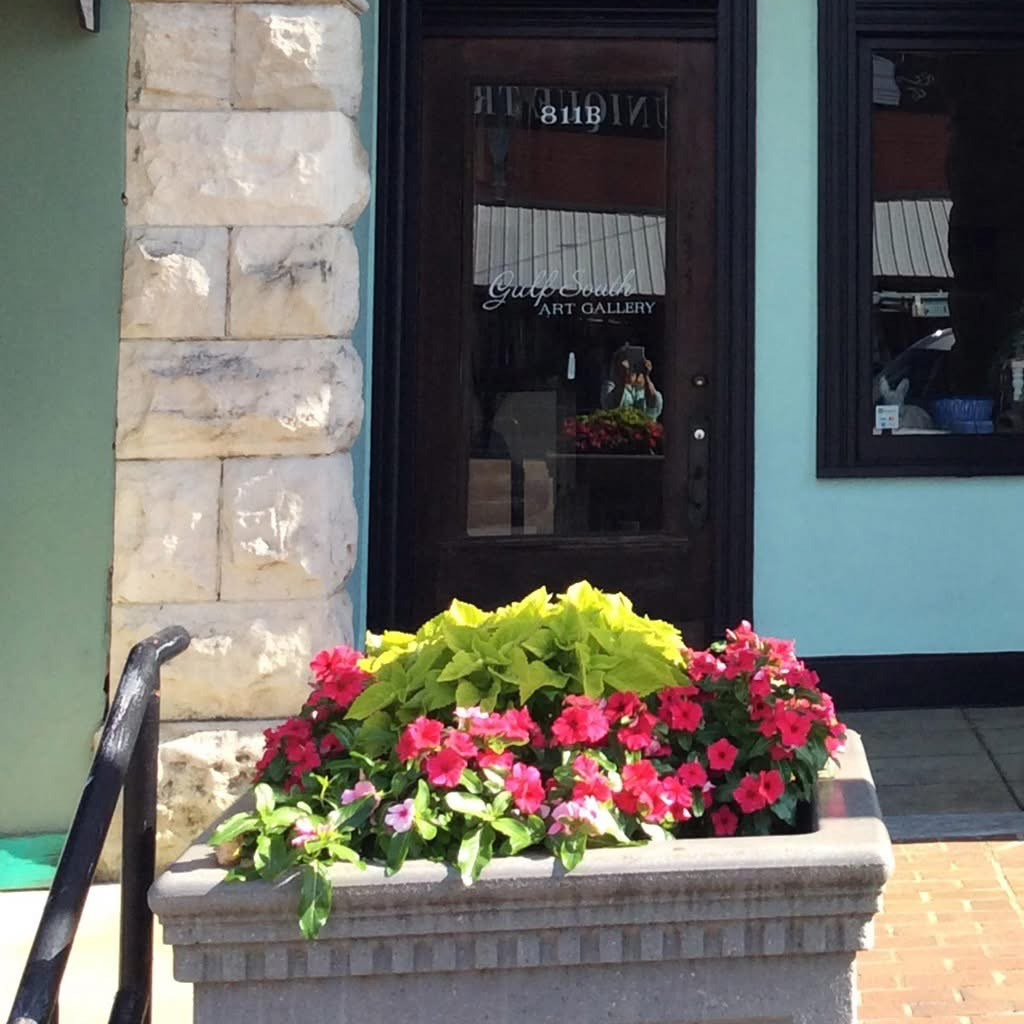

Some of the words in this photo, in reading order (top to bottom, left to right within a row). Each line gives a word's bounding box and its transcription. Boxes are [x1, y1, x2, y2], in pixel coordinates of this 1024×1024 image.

[540, 105, 602, 125] 811B
[482, 270, 560, 310] Gulf
[559, 269, 636, 298] South
[538, 302, 576, 316] ART
[581, 301, 657, 314] GALLERY
